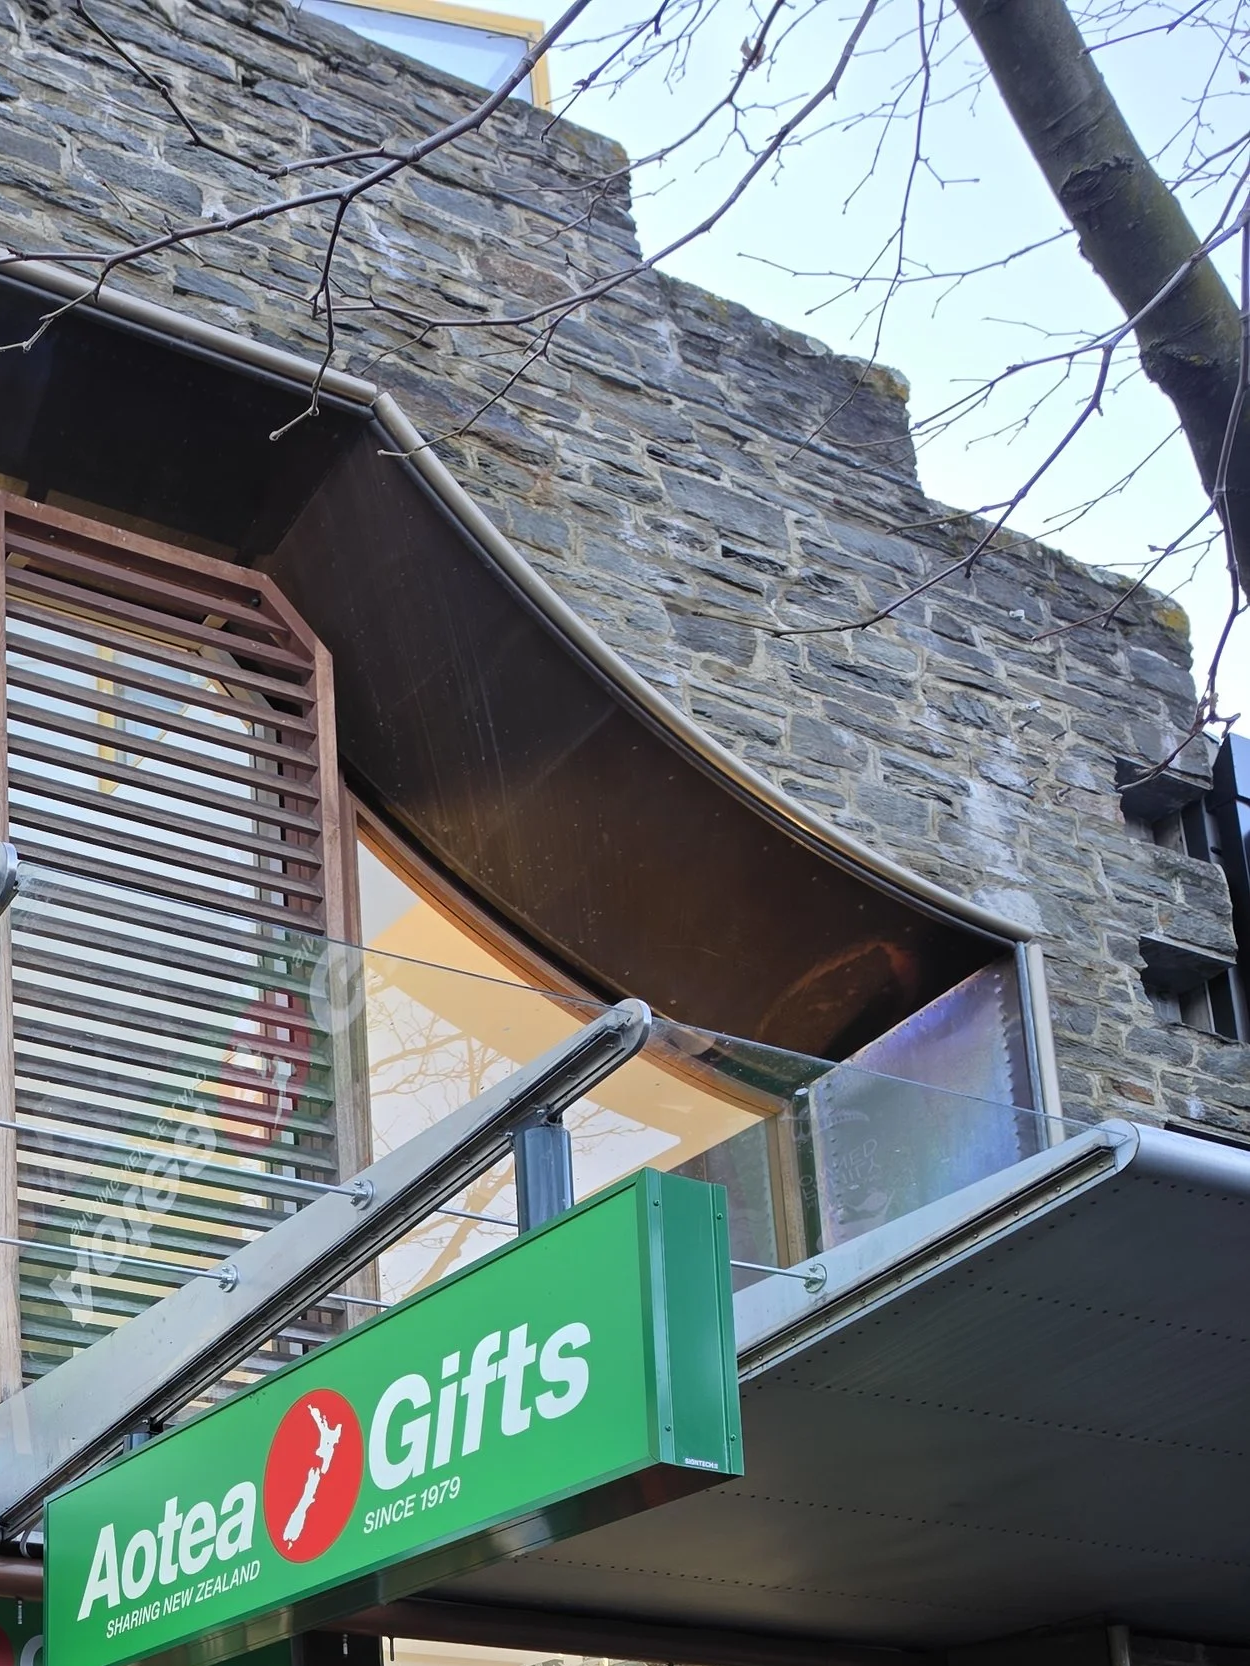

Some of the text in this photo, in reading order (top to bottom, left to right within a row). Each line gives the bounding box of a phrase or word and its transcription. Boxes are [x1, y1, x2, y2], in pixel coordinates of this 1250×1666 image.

[77, 1321, 592, 1622] Aotea Gifts
[363, 1476, 461, 1534] SINCE 1979
[106, 1560, 261, 1639] SHARING NEW ZEALAND
